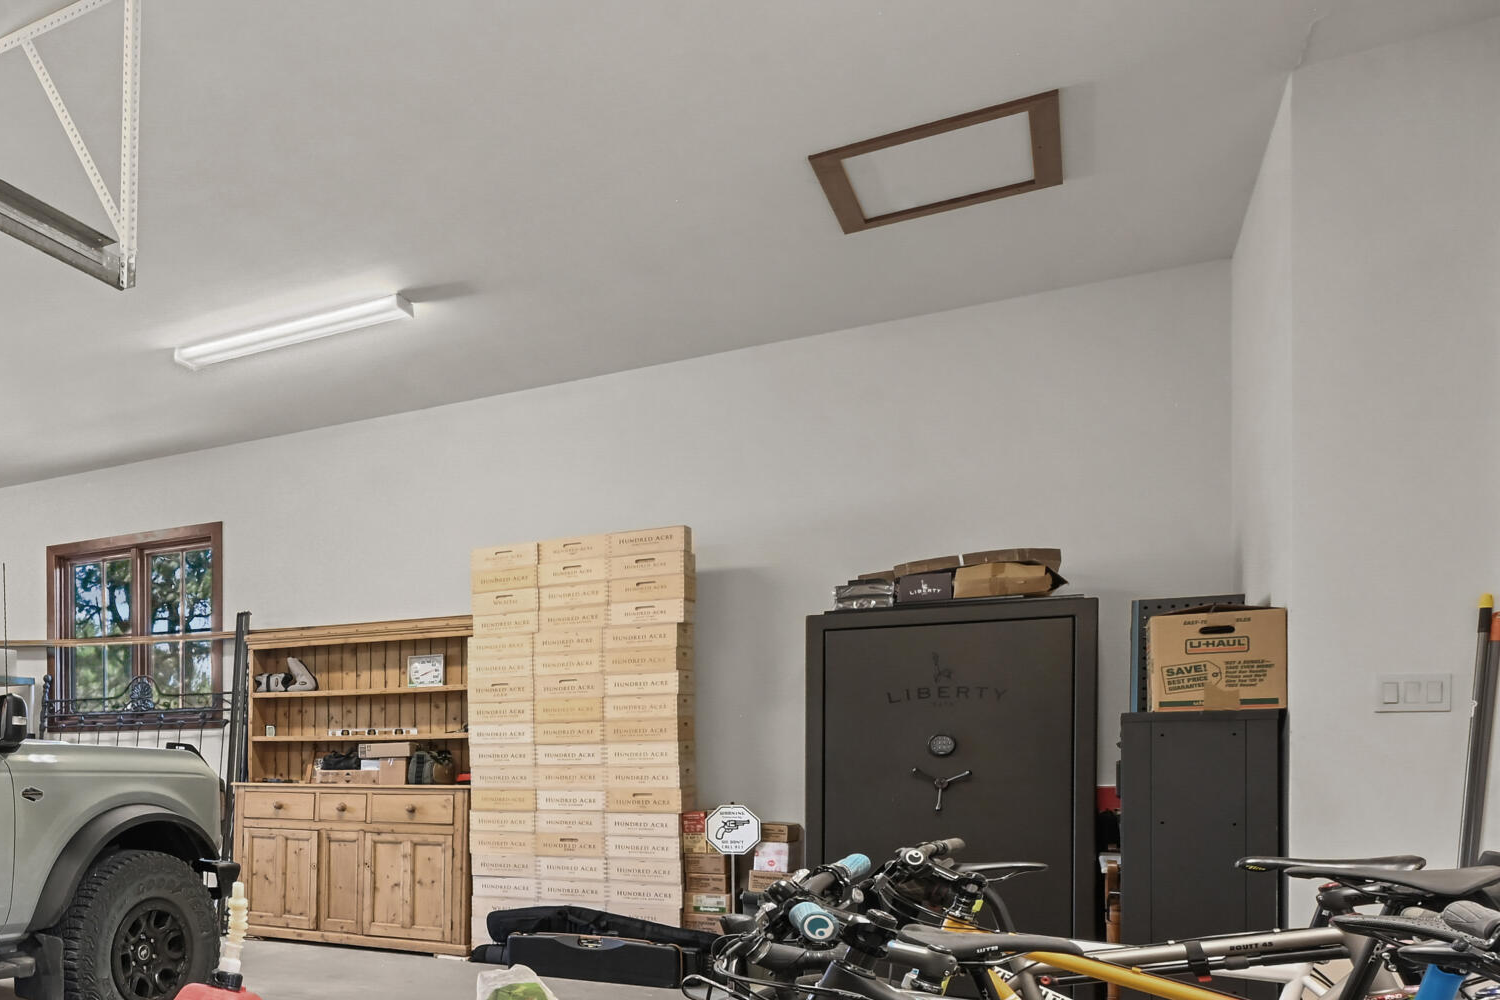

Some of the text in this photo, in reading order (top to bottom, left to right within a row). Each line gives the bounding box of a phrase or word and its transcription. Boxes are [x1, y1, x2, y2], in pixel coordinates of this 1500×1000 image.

[618, 533, 674, 545] HUNDRED ACRE
[909, 586, 942, 596] LIBERTY
[612, 631, 668, 641] HUNDRED ACRE
[1189, 638, 1246, 649] U-HAUL
[1166, 664, 1208, 677] SAVE!
[577, 683, 596, 691] ACRE
[650, 679, 669, 687] ACRE
[887, 685, 1009, 704] LIBERTY
[578, 751, 596, 759] ACRE
[614, 750, 669, 758] HUNDRED ACRE
[545, 796, 597, 804] HUNDRED ACRE
[650, 821, 669, 829] ACRE
[652, 868, 671, 876] ACRE
[581, 887, 599, 895] ACRE
[616, 890, 652, 898] HUNDRED
[653, 891, 672, 900] ACRE
